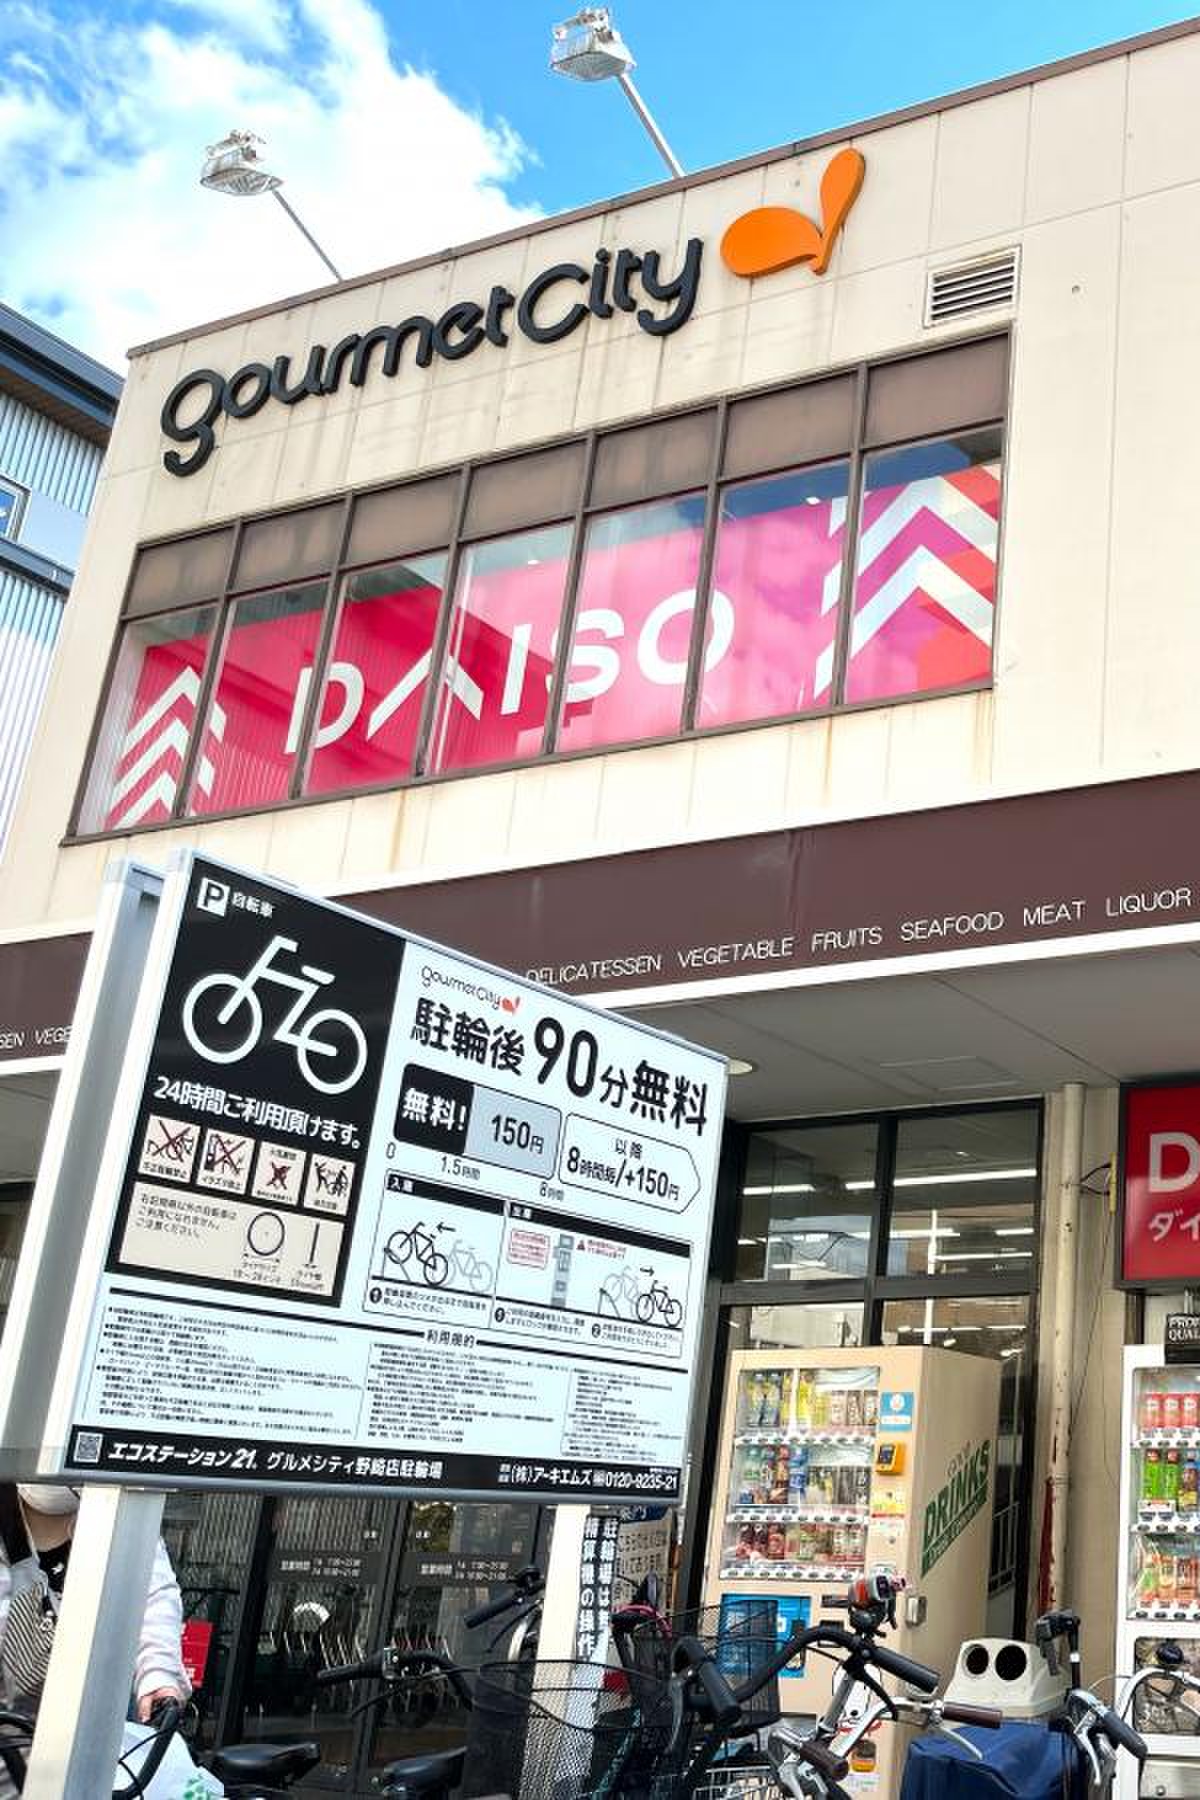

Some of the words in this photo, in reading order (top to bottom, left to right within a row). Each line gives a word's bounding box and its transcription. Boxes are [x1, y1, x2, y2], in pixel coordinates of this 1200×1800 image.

[160, 236, 706, 478] gourmetCity
[284, 588, 736, 754] DAISO
[526, 954, 662, 987] DELICATESSEN
[677, 936, 795, 968] VEGETABLE
[811, 926, 883, 954] FRUITS
[900, 910, 1004, 943] SEAFOOD
[1023, 900, 1086, 927] MEAT
[1106, 887, 1193, 917] LIQUOR
[491, 1114, 545, 1155] 150円
